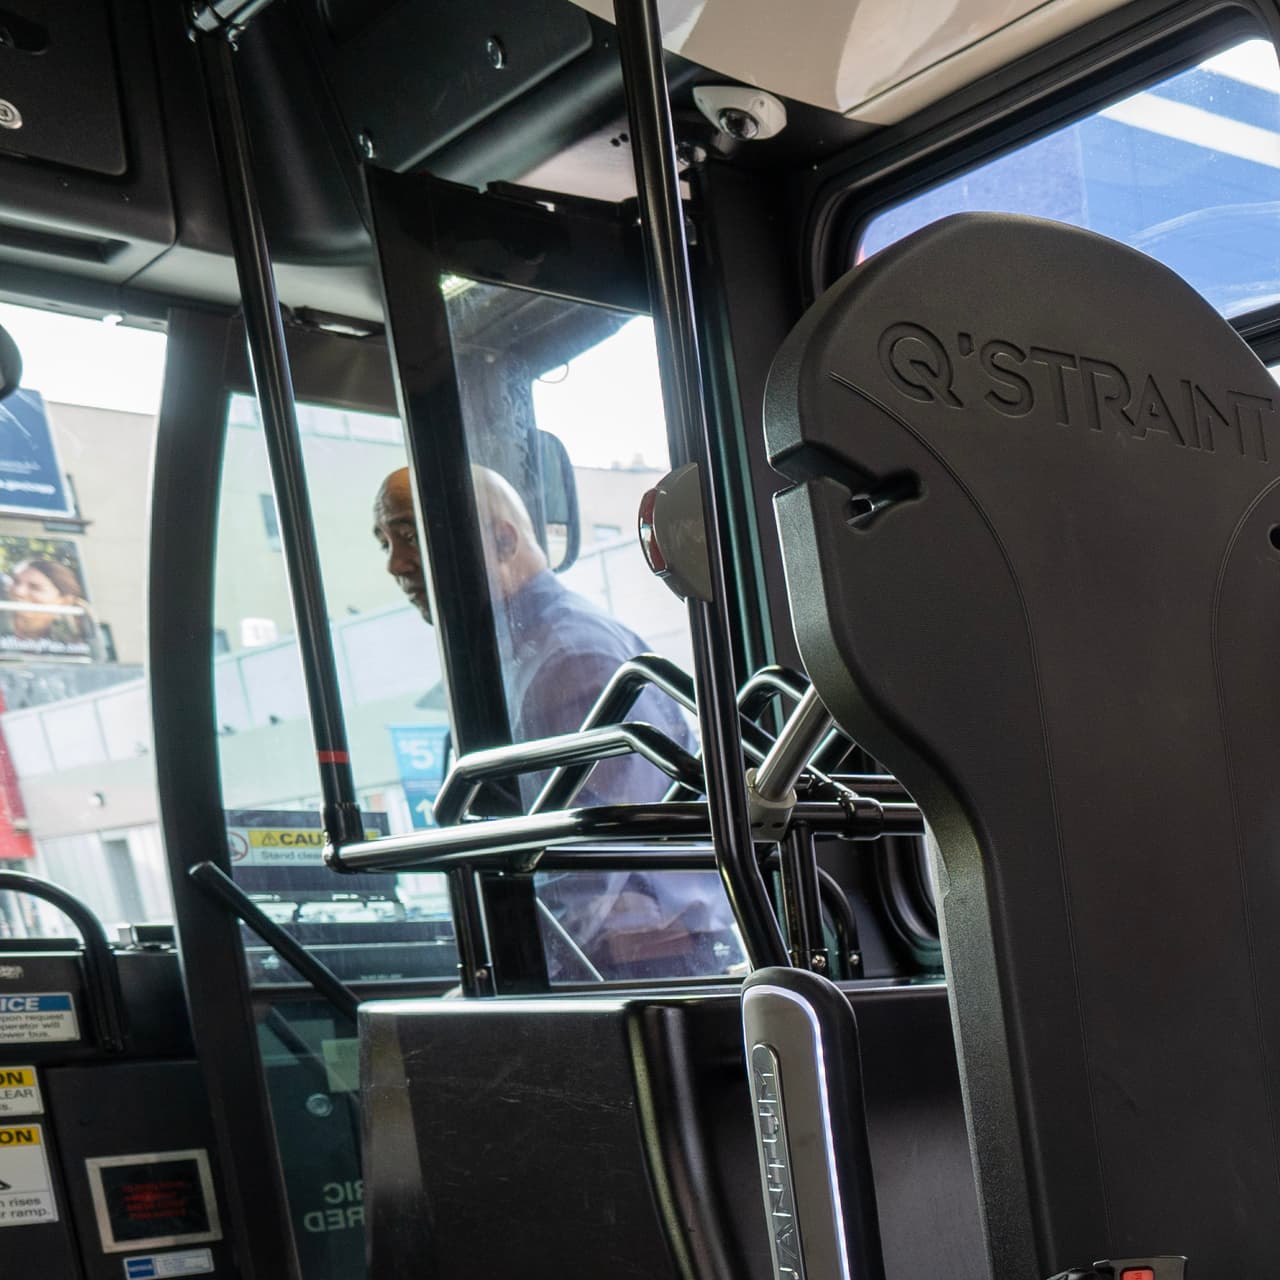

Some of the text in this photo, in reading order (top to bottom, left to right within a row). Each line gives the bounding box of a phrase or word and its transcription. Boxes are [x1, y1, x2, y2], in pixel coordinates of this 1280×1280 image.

[878, 321, 1274, 463] Q'STRAINT
[25, 1013, 64, 1022] request
[42, 1021, 60, 1029] will
[9, 1197, 41, 1207] rises
[10, 1207, 50, 1218] ramp.
